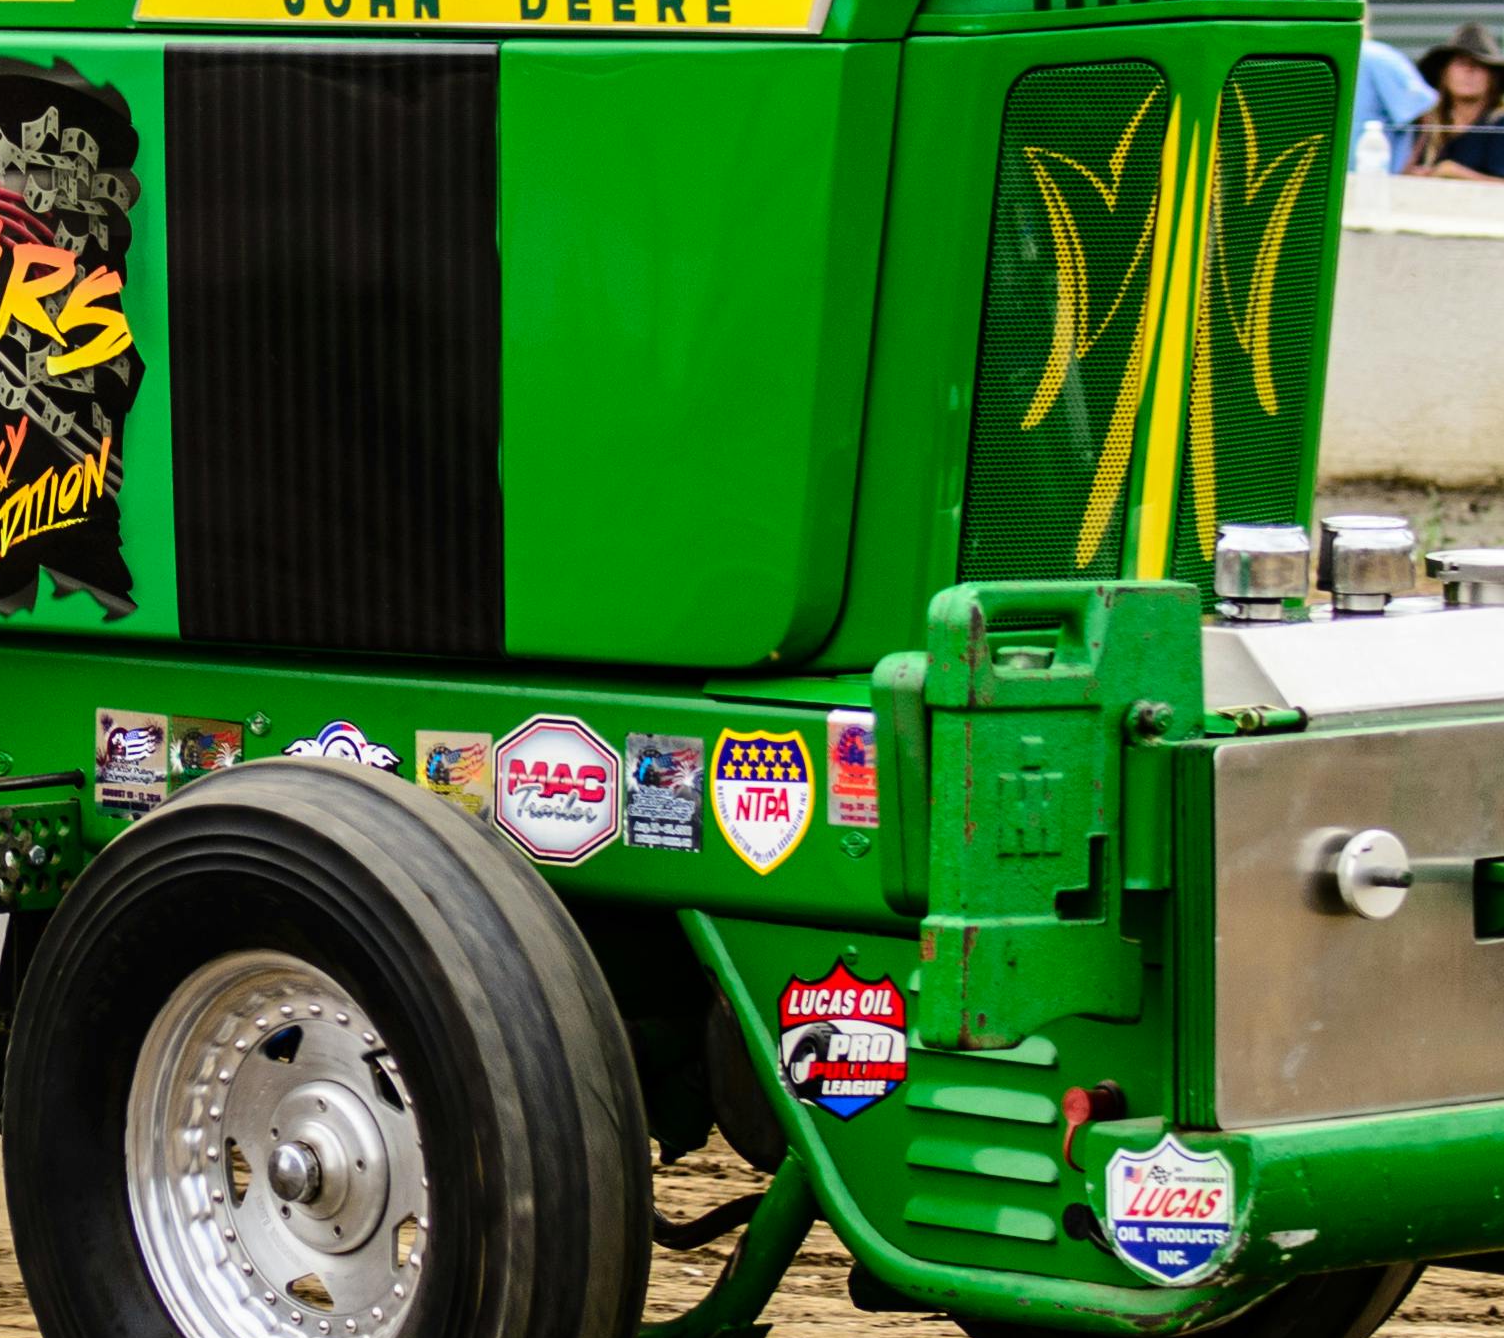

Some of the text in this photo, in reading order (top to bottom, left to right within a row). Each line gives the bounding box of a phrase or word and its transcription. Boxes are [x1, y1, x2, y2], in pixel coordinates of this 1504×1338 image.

[508, 759, 607, 803] MAC
[514, 785, 598, 823] Trailer
[736, 787, 791, 823] NTPA
[788, 989, 893, 1016] LUCAS OIL
[827, 1033, 894, 1062] PRO
[807, 1061, 906, 1080] PULLING
[821, 1080, 887, 1096] LEAGUE
[1124, 1187, 1223, 1219] LUCAS
[1117, 1226, 1226, 1245] OIL PRODUCTS
[1156, 1249, 1190, 1266] INC.
